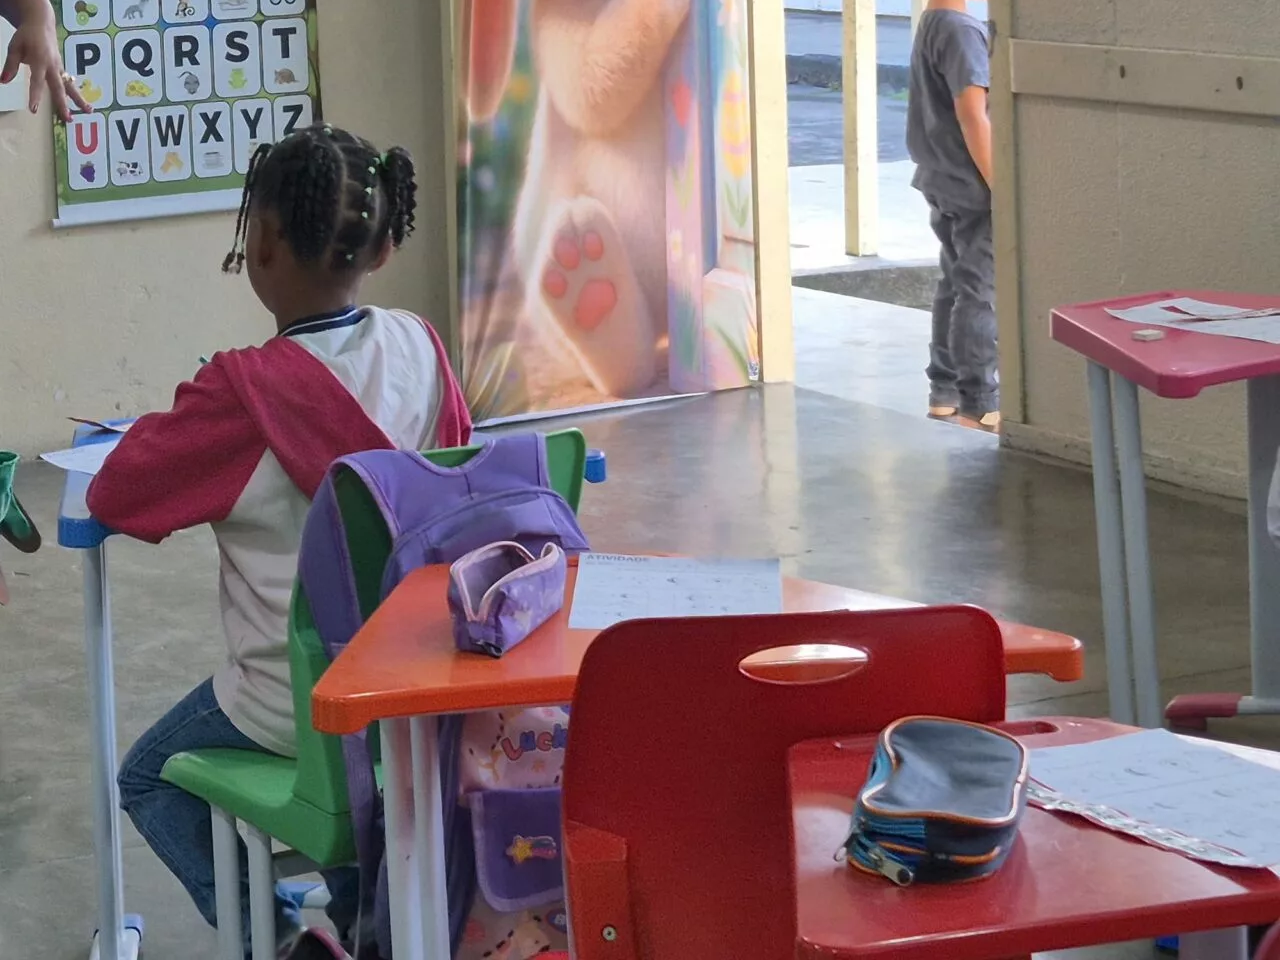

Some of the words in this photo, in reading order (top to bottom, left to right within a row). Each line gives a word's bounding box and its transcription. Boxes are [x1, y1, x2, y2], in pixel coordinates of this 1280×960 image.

[75, 43, 101, 75] P
[122, 39, 155, 77] Q
[173, 35, 200, 67] R
[225, 31, 250, 63] S
[272, 27, 297, 58] T
[75, 122, 98, 154] U
[116, 118, 140, 150] V
[154, 114, 185, 147] W
[200, 111, 224, 144] X
[240, 107, 263, 139] Y
[282, 104, 304, 136] Z
